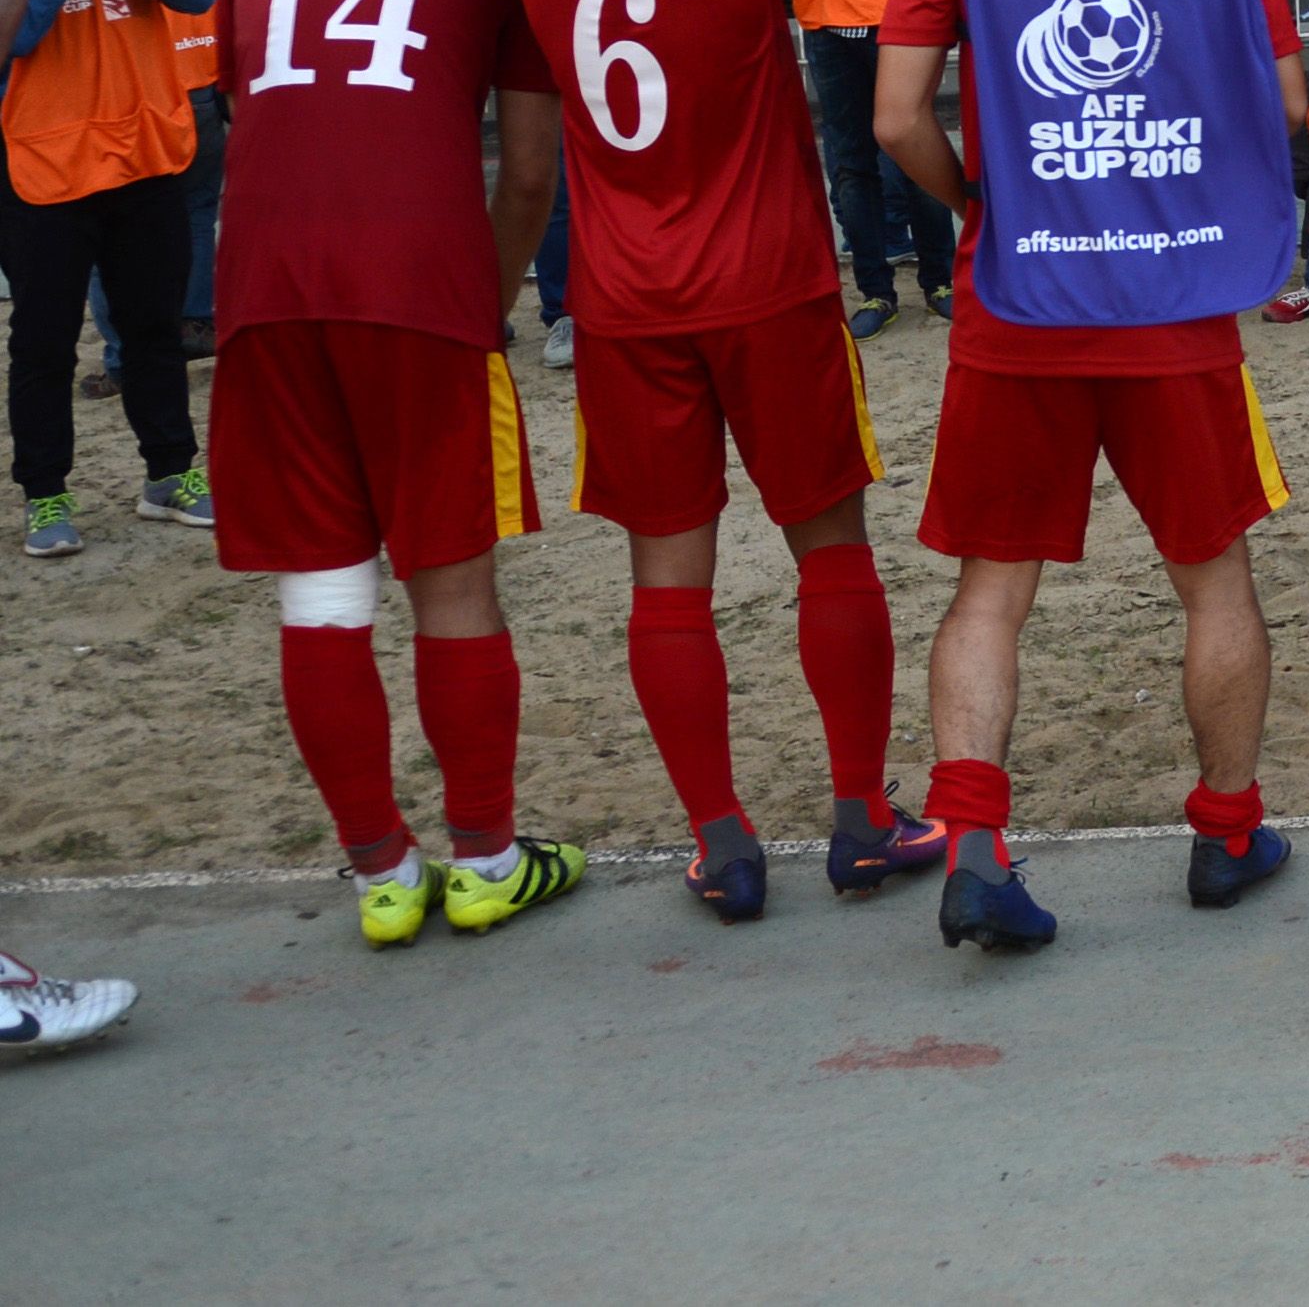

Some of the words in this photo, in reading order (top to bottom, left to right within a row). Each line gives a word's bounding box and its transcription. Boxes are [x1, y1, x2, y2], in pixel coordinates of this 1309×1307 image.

[1081, 94, 1147, 119] AFF
[1029, 117, 1202, 150] SUZUKI
[1031, 150, 1126, 181] CUP
[1129, 146, 1202, 179] 2016
[1016, 225, 1224, 255] affsuzukicup.com
